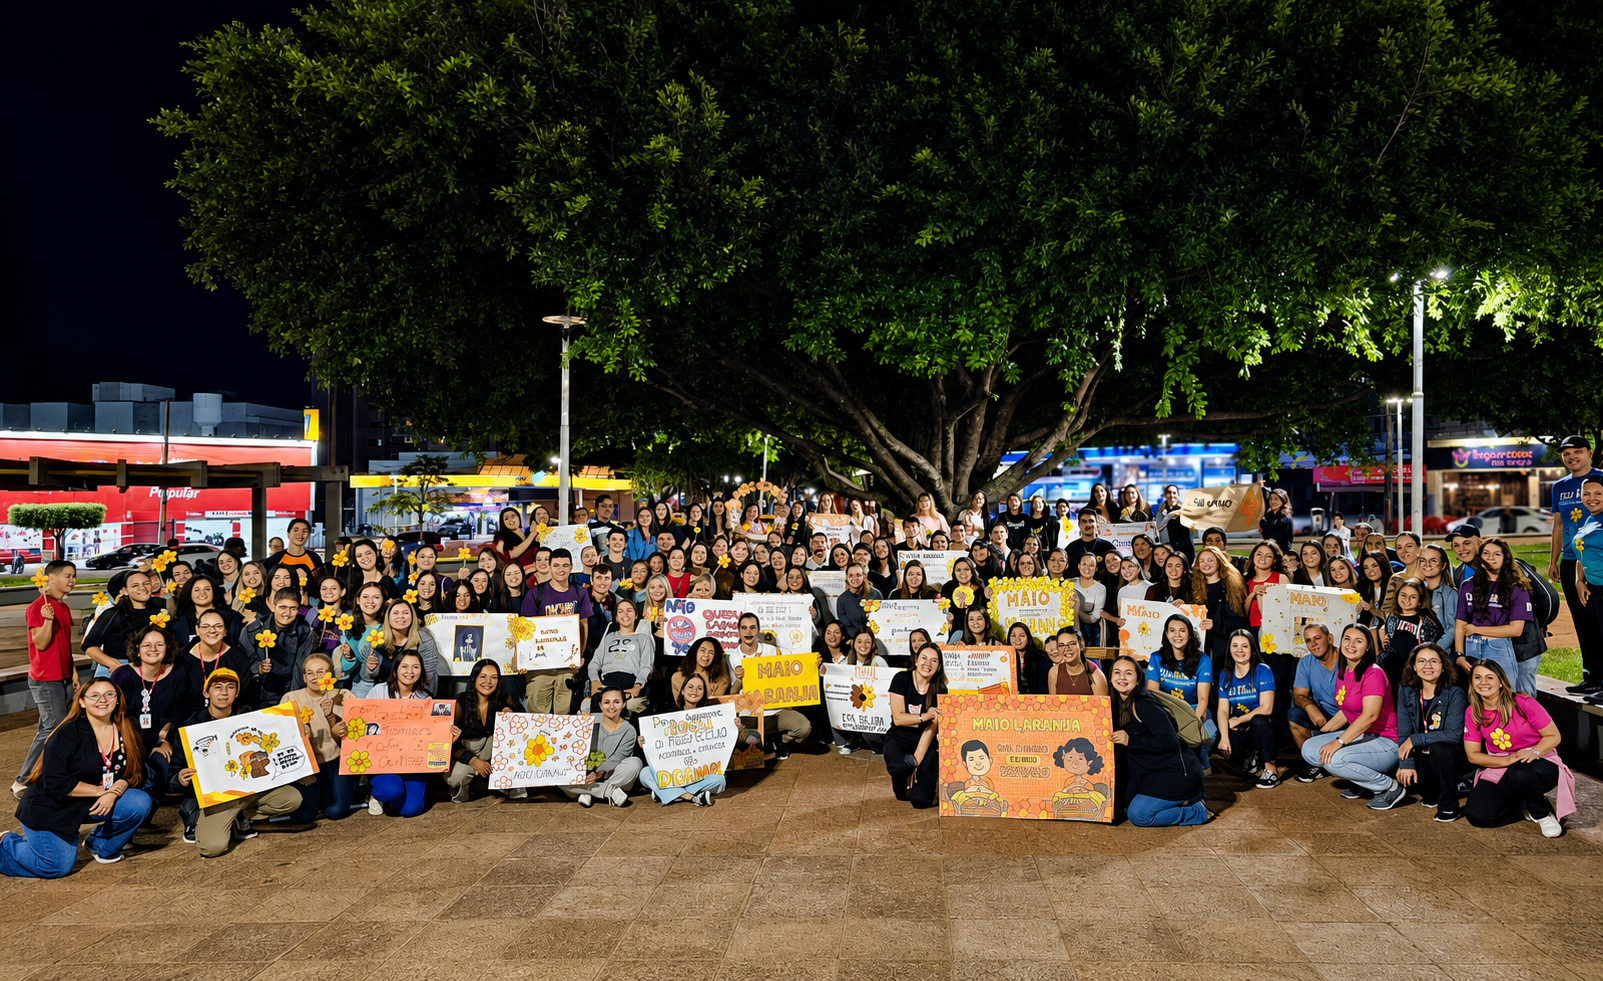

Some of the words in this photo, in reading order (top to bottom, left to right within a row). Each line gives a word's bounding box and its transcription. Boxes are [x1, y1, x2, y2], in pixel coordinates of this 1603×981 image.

[1006, 589, 1050, 607] MAIO
[1290, 591, 1327, 607] MAIO
[757, 659, 803, 679] MAIO
[971, 717, 1010, 731] MAIO
